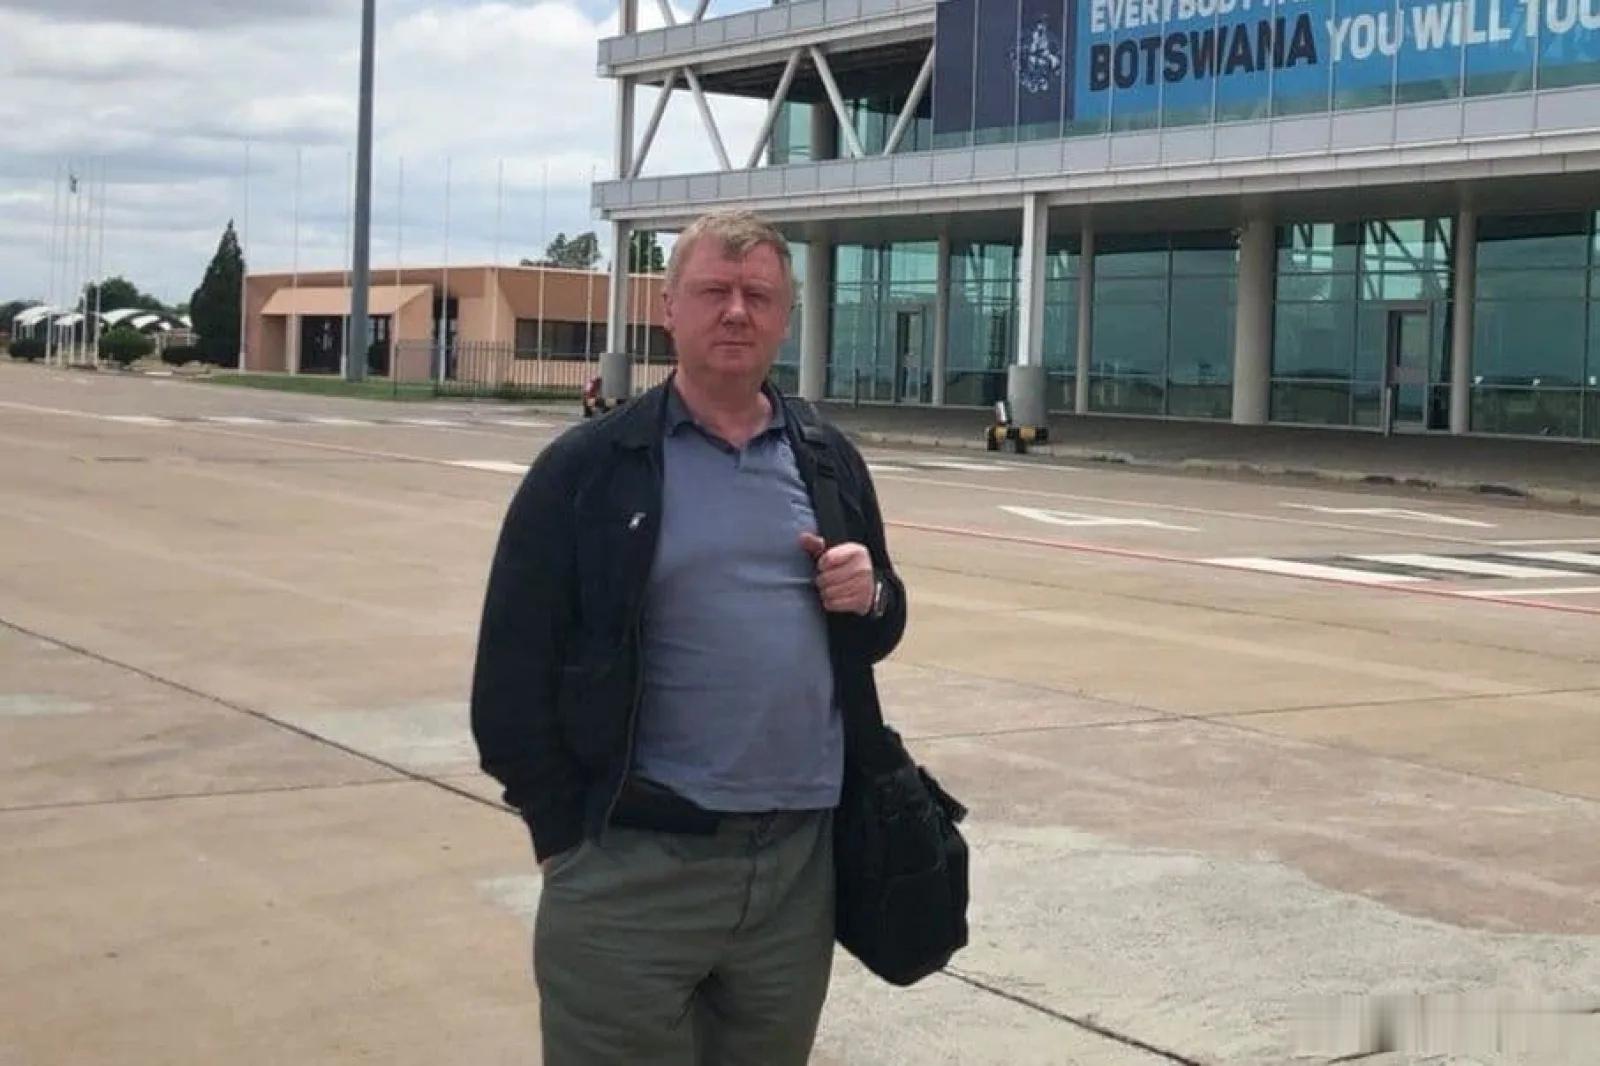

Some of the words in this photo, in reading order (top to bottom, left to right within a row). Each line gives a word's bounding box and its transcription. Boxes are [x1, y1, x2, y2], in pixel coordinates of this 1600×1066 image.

[1090, 13, 1317, 91] BOTSWANA
[1326, 10, 1404, 61] YOU
[1411, 0, 1512, 50] WILL
[1091, 0, 1251, 33] EVERYB
